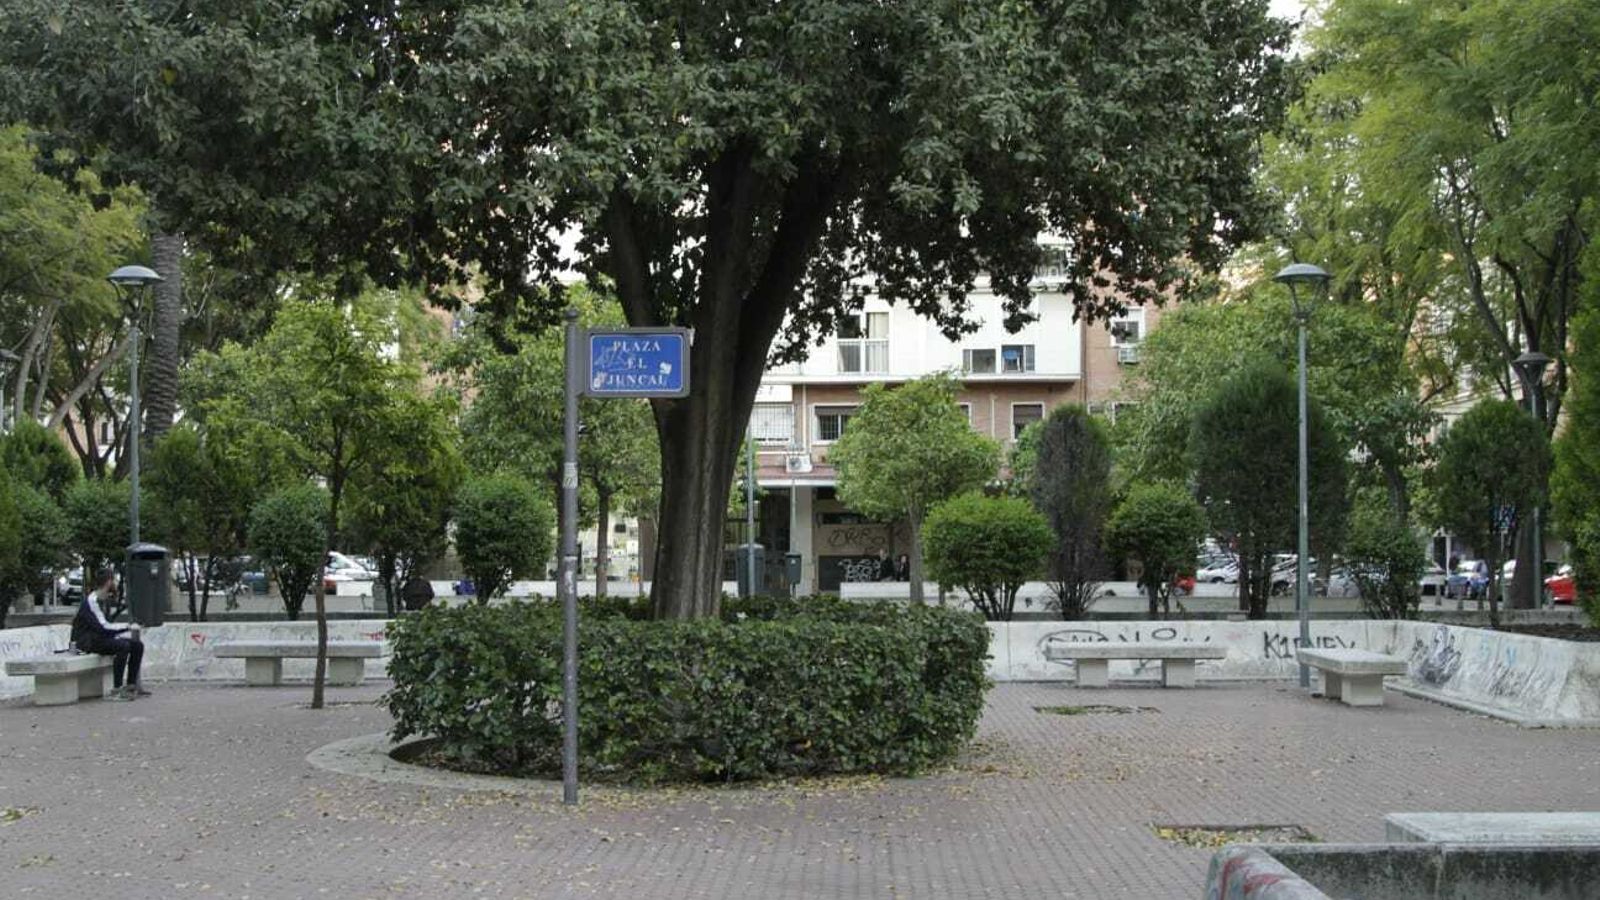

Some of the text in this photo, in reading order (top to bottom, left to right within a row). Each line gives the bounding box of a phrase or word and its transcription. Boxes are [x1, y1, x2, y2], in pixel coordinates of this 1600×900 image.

[613, 341, 661, 351] PLAZA
[627, 357, 647, 369] EL
[607, 374, 666, 385] JUNCAL
